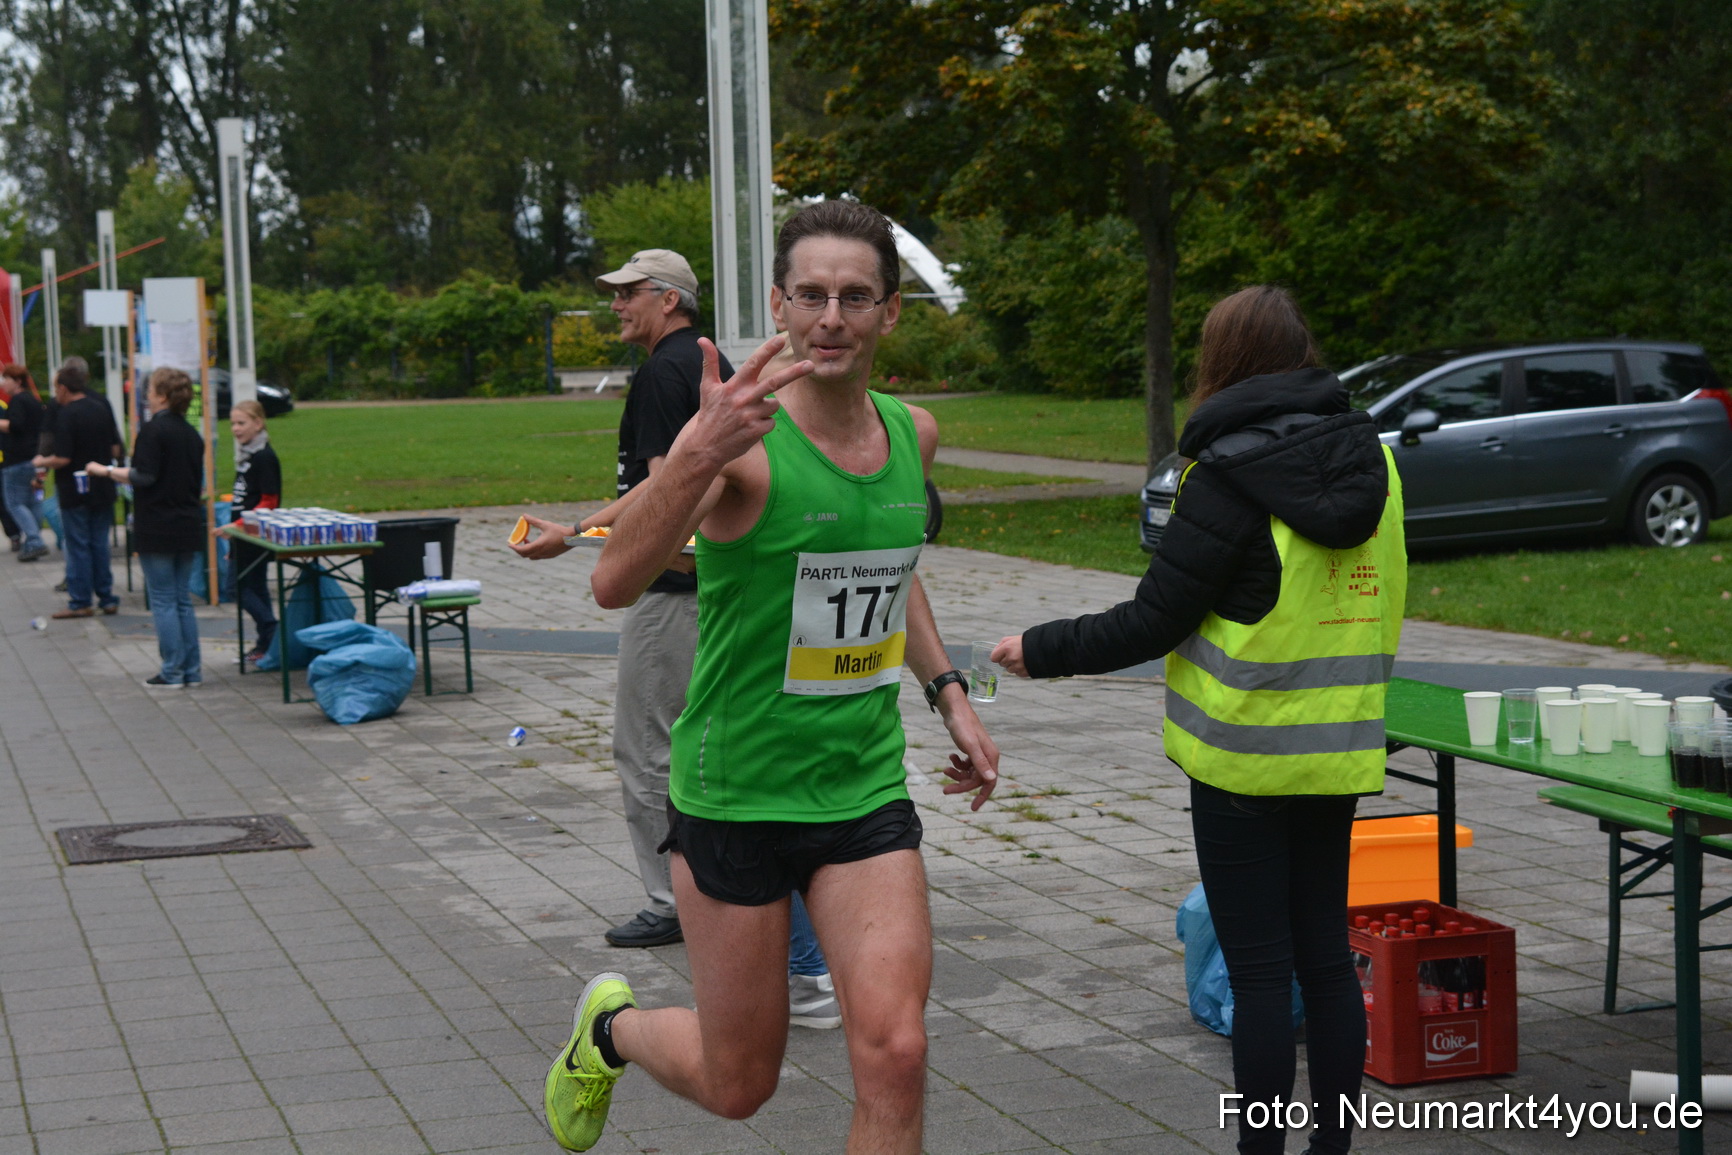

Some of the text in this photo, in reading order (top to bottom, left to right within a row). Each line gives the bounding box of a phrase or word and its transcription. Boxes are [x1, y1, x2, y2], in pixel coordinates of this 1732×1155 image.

[816, 512, 839, 522] JAKO
[800, 562, 910, 581] PARTL Neumarkt
[827, 582, 902, 640] 177
[796, 636, 803, 646] A
[834, 650, 883, 675] Martin
[1432, 1031, 1467, 1051] Coke
